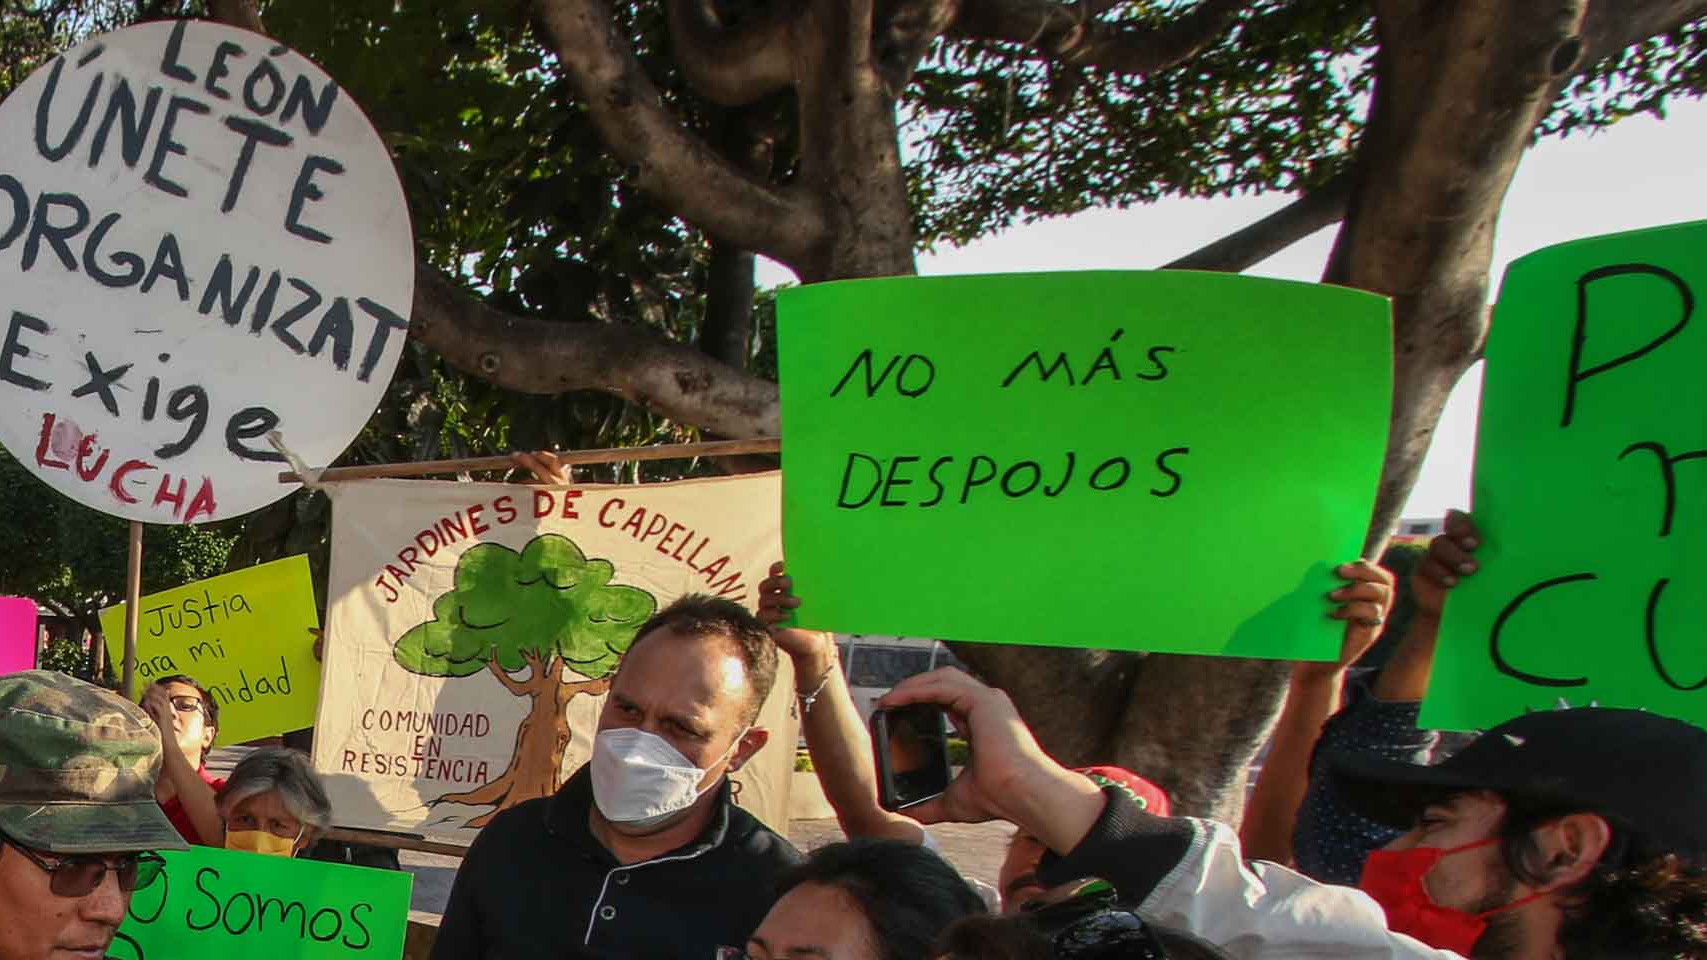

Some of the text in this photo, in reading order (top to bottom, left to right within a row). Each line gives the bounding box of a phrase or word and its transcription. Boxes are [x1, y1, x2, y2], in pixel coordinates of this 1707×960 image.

[160, 19, 338, 136] LEÓN
[35, 44, 345, 244] ÚNETE
[830, 328, 1177, 398] NO MÁS
[35, 412, 218, 523] LUCHA
[836, 447, 1190, 509] DESPOJOS
[374, 495, 518, 604] JARDINES
[534, 490, 583, 520] DE
[206, 656, 292, 705] nidad
[362, 708, 490, 738] COMUNIDAD
[413, 734, 442, 760] EN
[342, 749, 489, 785] RESISTENCIA
[186, 867, 373, 950] Somos
